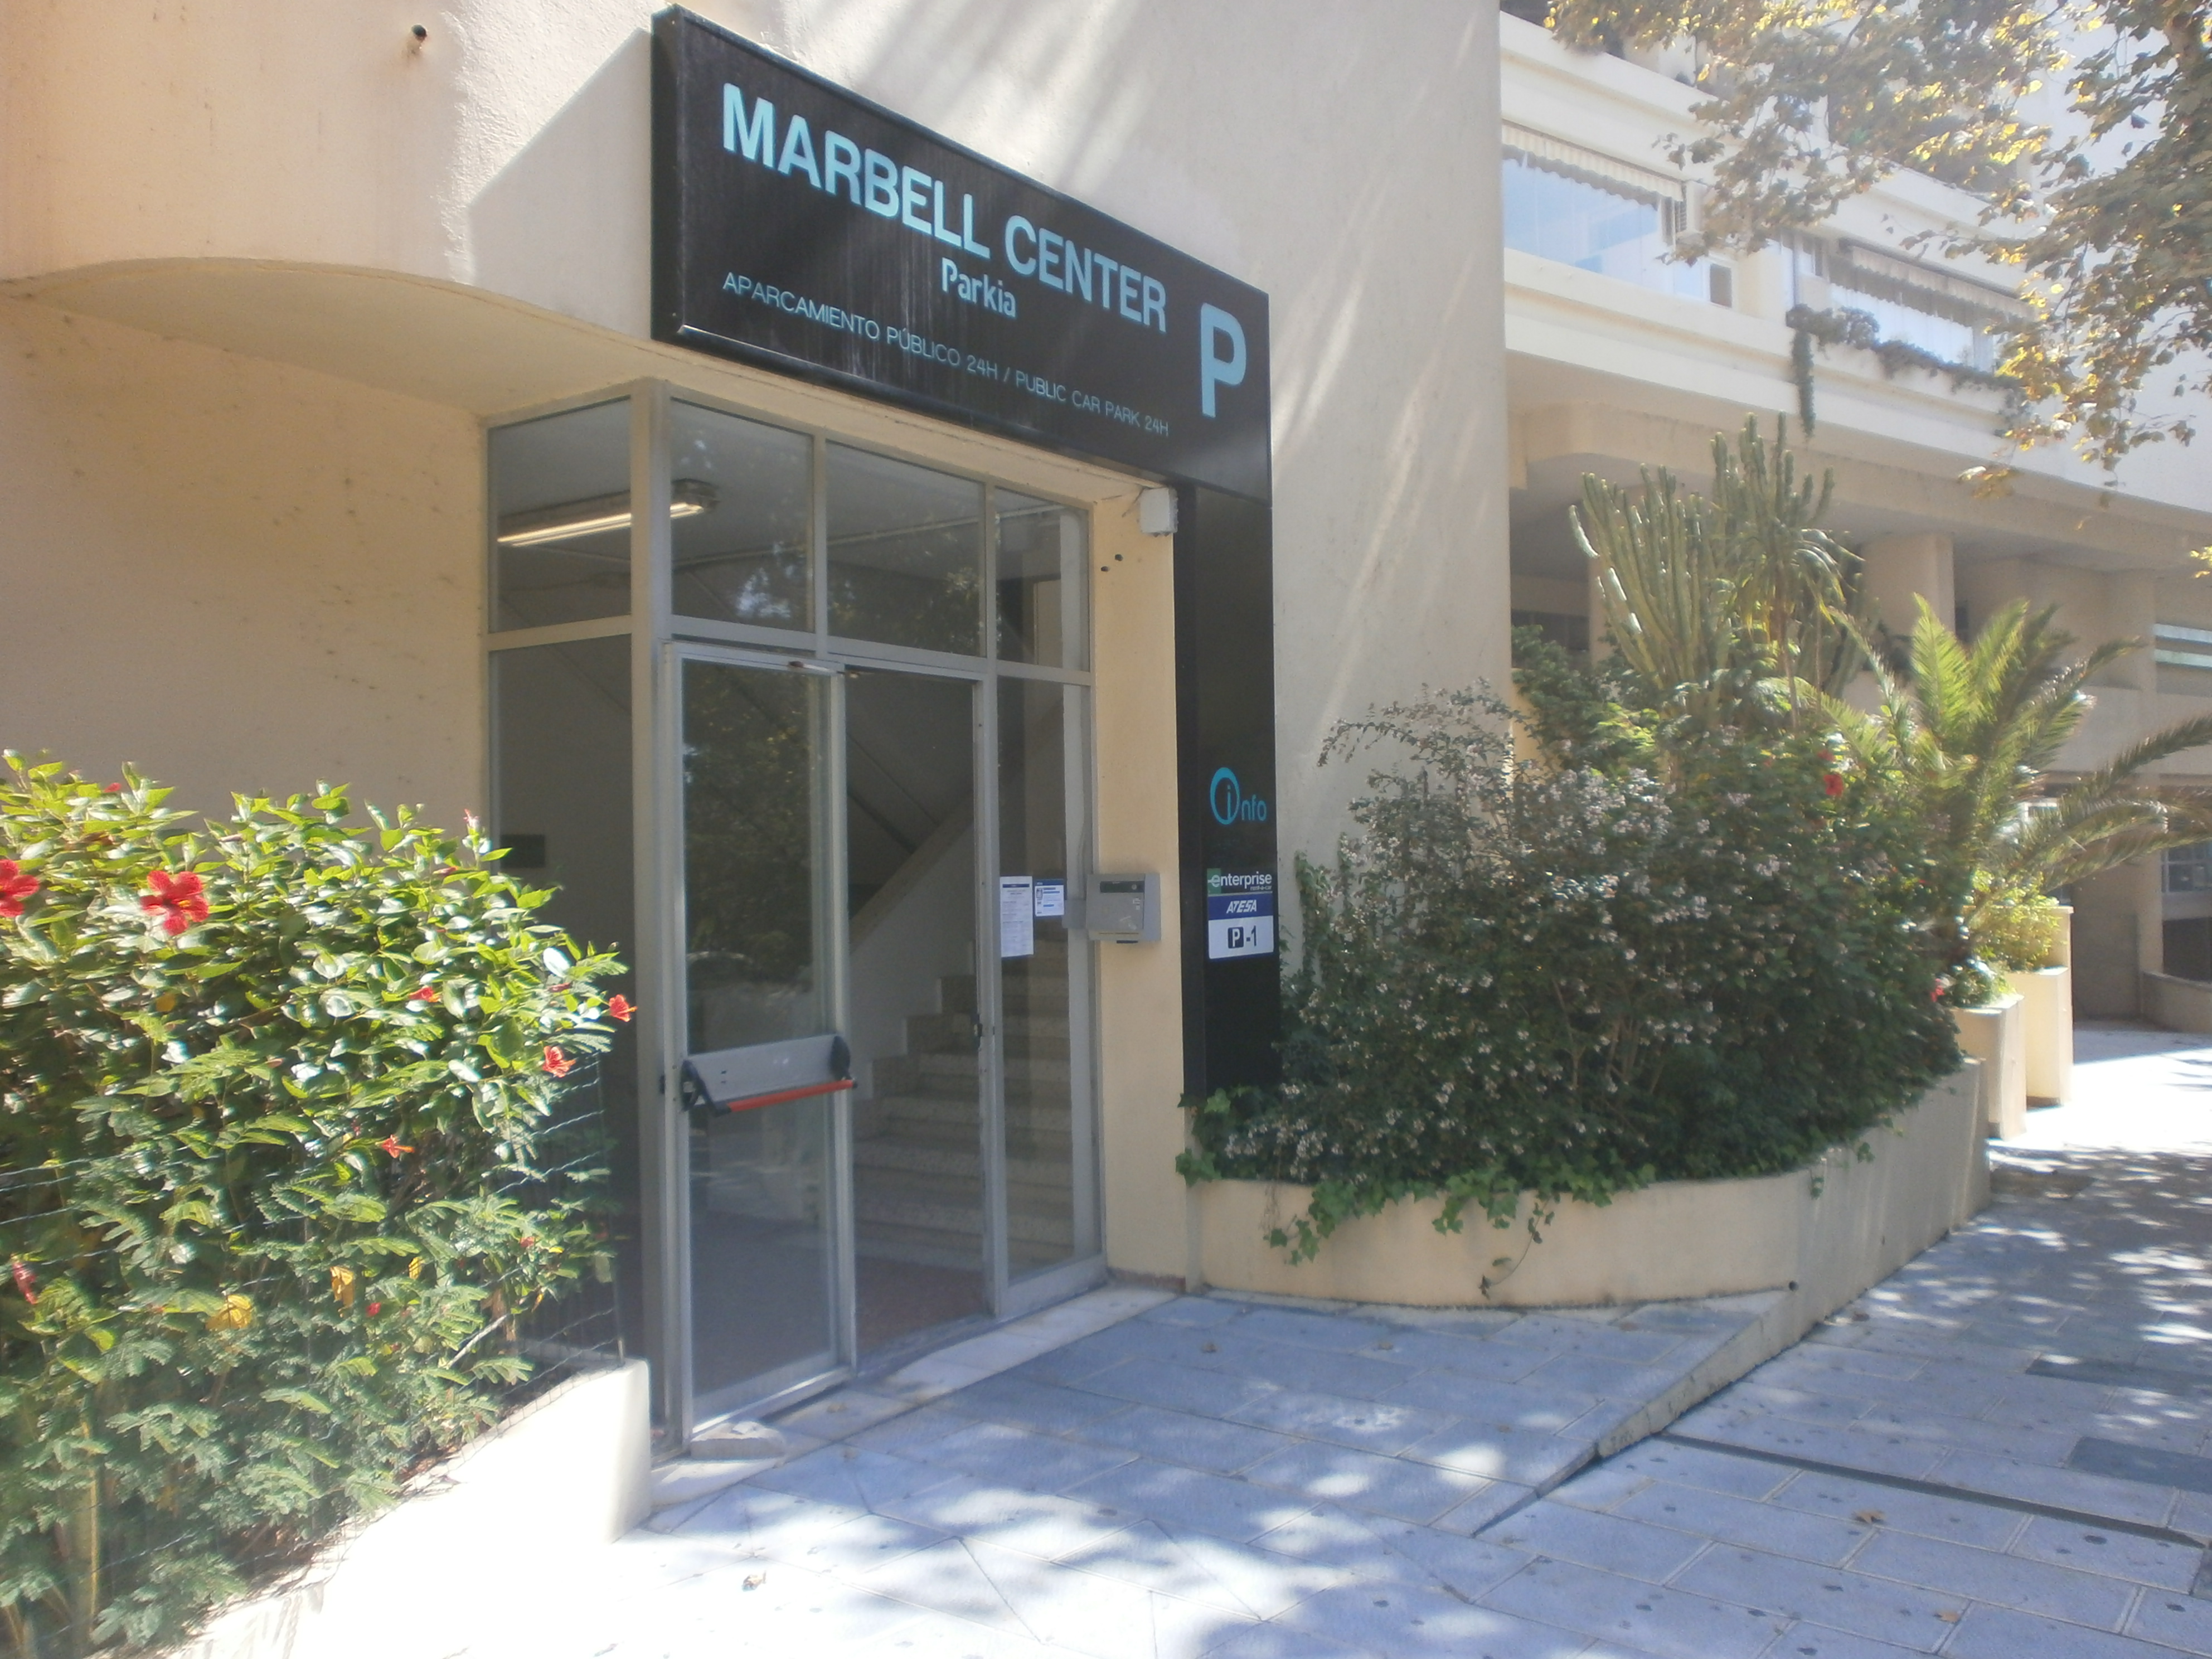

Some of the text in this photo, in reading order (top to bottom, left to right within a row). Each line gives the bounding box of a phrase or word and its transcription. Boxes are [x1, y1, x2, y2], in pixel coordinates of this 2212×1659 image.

[723, 83, 1166, 333] MARBELL CENTER
[942, 258, 1017, 318] Parkia
[722, 272, 1169, 436] APARCAMIENTO PÚBLICO 24H / PUBLIC CAR PARK 24H
[1201, 302, 1246, 419] P
[1208, 871, 1273, 890] enterprise
[1226, 899, 1257, 914] ATESA
